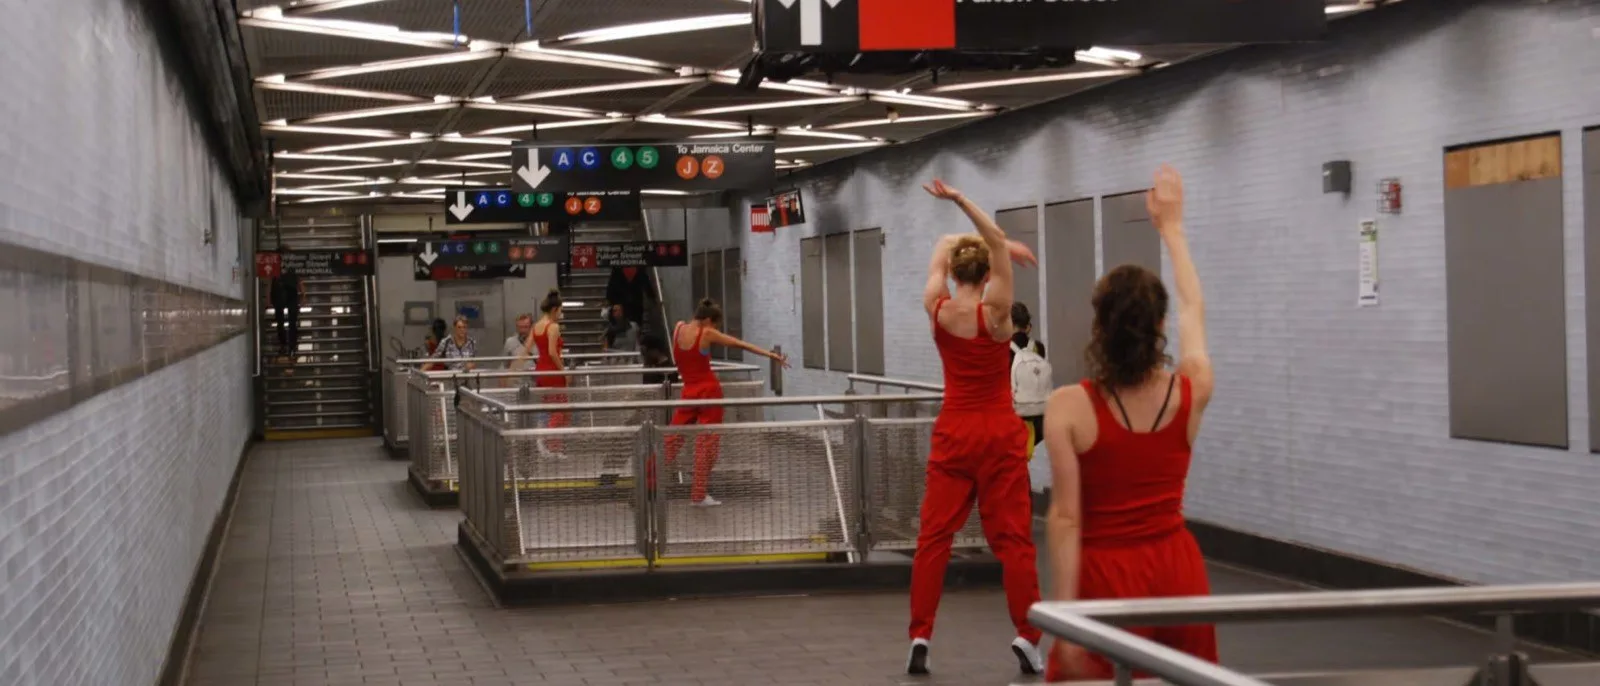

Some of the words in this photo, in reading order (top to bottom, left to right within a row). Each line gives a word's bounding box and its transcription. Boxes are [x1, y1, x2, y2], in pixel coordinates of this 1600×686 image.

[676, 145, 688, 154] To
[691, 145, 730, 154] Jamaica
[732, 143, 764, 153] Center
[558, 152, 569, 166] A
[583, 152, 595, 165] C
[616, 151, 627, 164] 4
[642, 150, 653, 164] 5
[682, 161, 692, 174] J
[707, 160, 718, 173] Z
[479, 195, 488, 205] A
[498, 194, 506, 204] C
[522, 193, 530, 204] 4
[541, 193, 549, 204] 5
